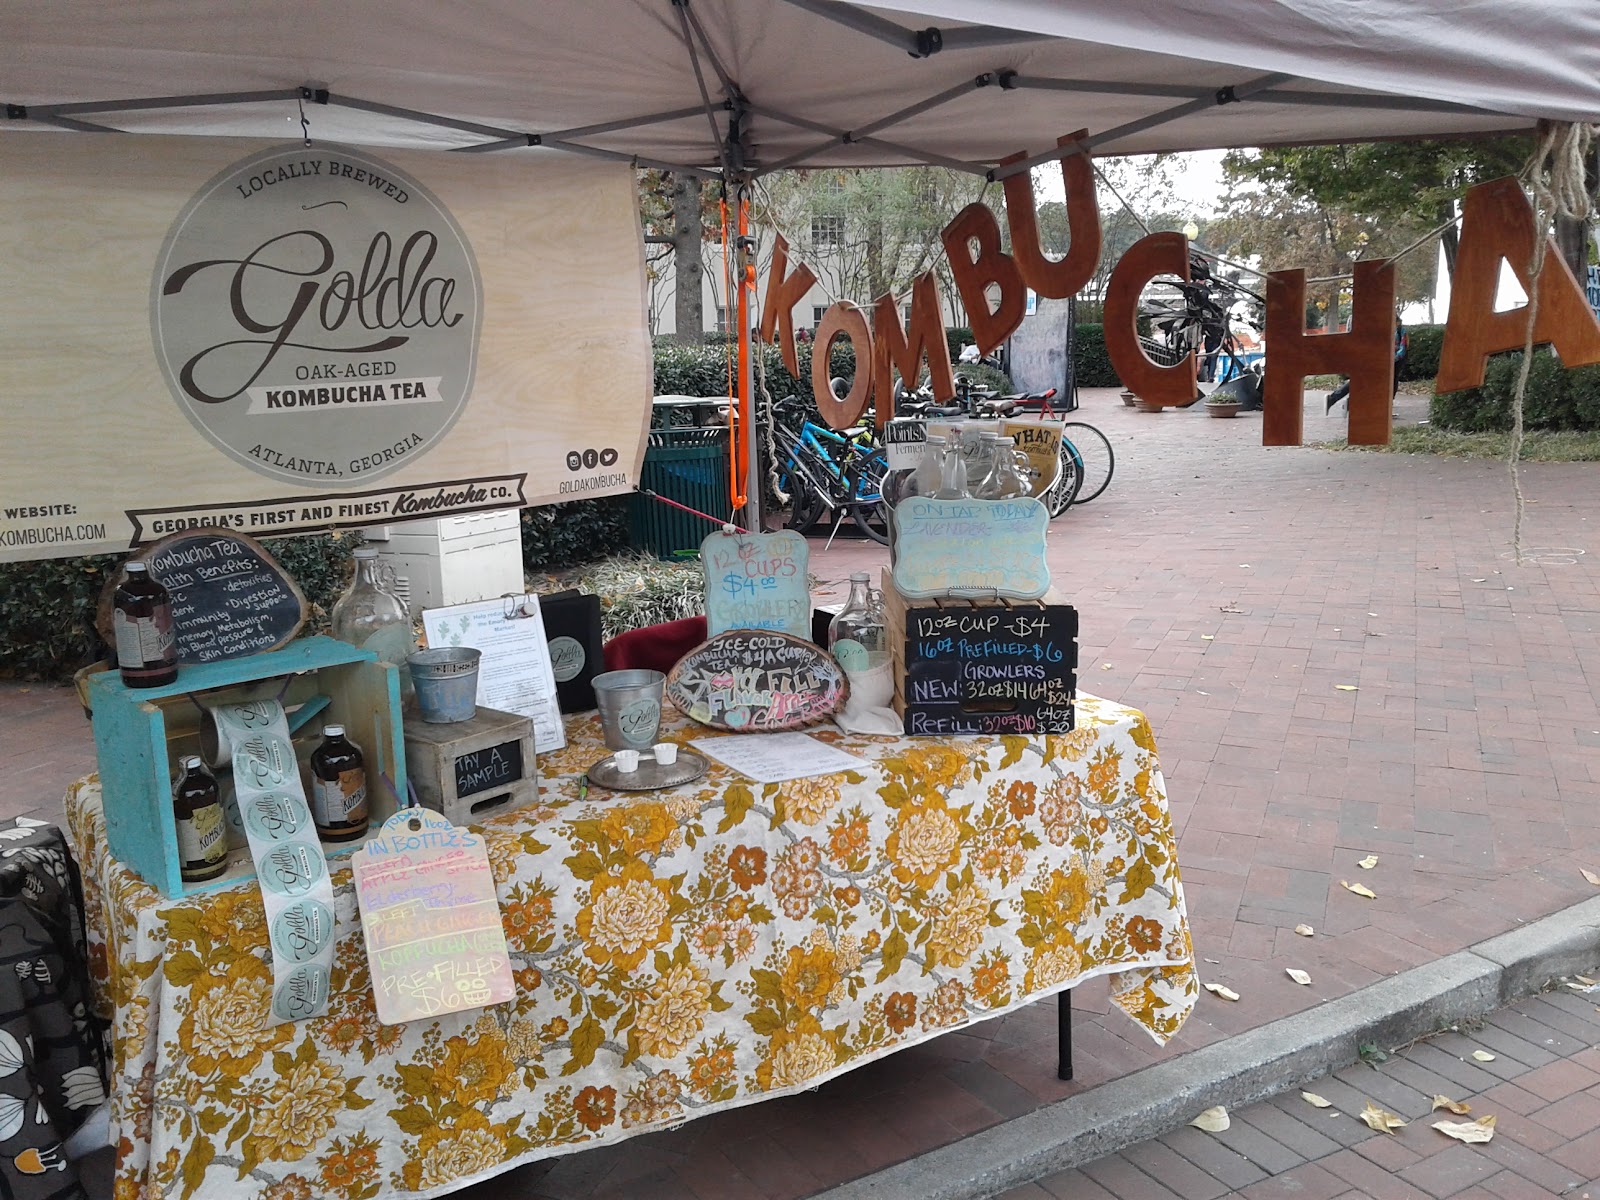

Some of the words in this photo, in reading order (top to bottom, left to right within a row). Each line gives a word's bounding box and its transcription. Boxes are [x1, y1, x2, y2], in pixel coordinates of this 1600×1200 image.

[236, 160, 322, 199] LOCALLY
[329, 161, 409, 204] BREWED
[760, 129, 1600, 446] KOMBUCHA
[163, 229, 464, 404] Golda
[296, 361, 397, 380] OAK-AGED
[266, 385, 387, 409] KOMBUCHA
[390, 382, 427, 400] TEA
[248, 444, 343, 478] ATLANTA,
[350, 432, 424, 473] GEORGIA
[895, 442, 926, 455] Fermen
[559, 473, 627, 494] GOLDAKOMBUCHA
[4, 504, 77, 519] WEBSITE:
[152, 514, 244, 534] GEORGIA'S
[250, 509, 296, 526] FIRST
[301, 507, 334, 521] AND
[338, 501, 390, 517] FINEST
[392, 484, 488, 516] Kombucha
[490, 486, 512, 499] CO.
[150, 545, 215, 574] Kombucha
[210, 540, 242, 557] Tea
[196, 558, 259, 580] Benefits:
[745, 557, 797, 578] CUPS
[960, 615, 999, 633] CUP
[964, 660, 1046, 680] GROWLERS
[913, 679, 963, 701] NEW:
[455, 753, 480, 772] TRY
[491, 748, 503, 765] A
[458, 761, 510, 793] SAMPLE
[366, 838, 388, 856] IN
[392, 831, 478, 856] BOTTLES
[381, 904, 421, 921] LEFT
[284, 903, 317, 960] Golda
